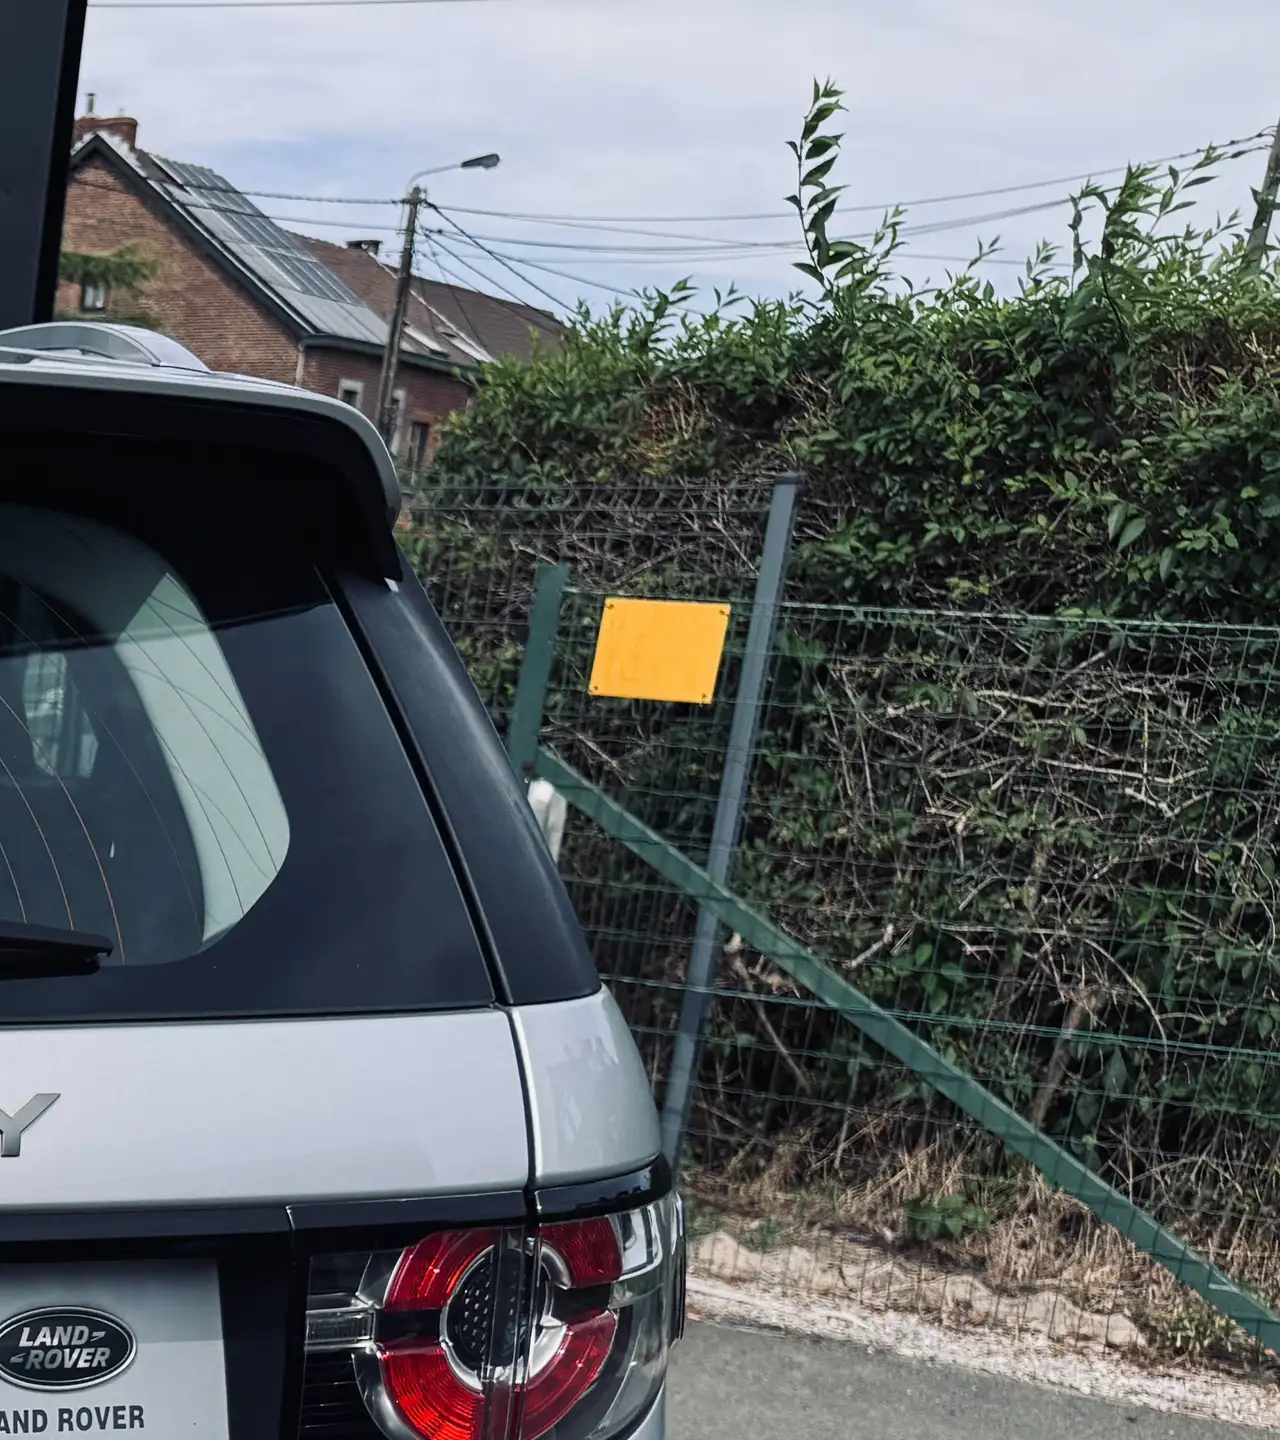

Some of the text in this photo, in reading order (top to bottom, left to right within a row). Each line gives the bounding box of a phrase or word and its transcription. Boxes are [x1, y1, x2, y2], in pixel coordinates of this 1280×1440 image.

[18, 1325, 90, 1348] LAND
[24, 1347, 111, 1370] ROVER
[58, 1405, 145, 1432] ROVER
